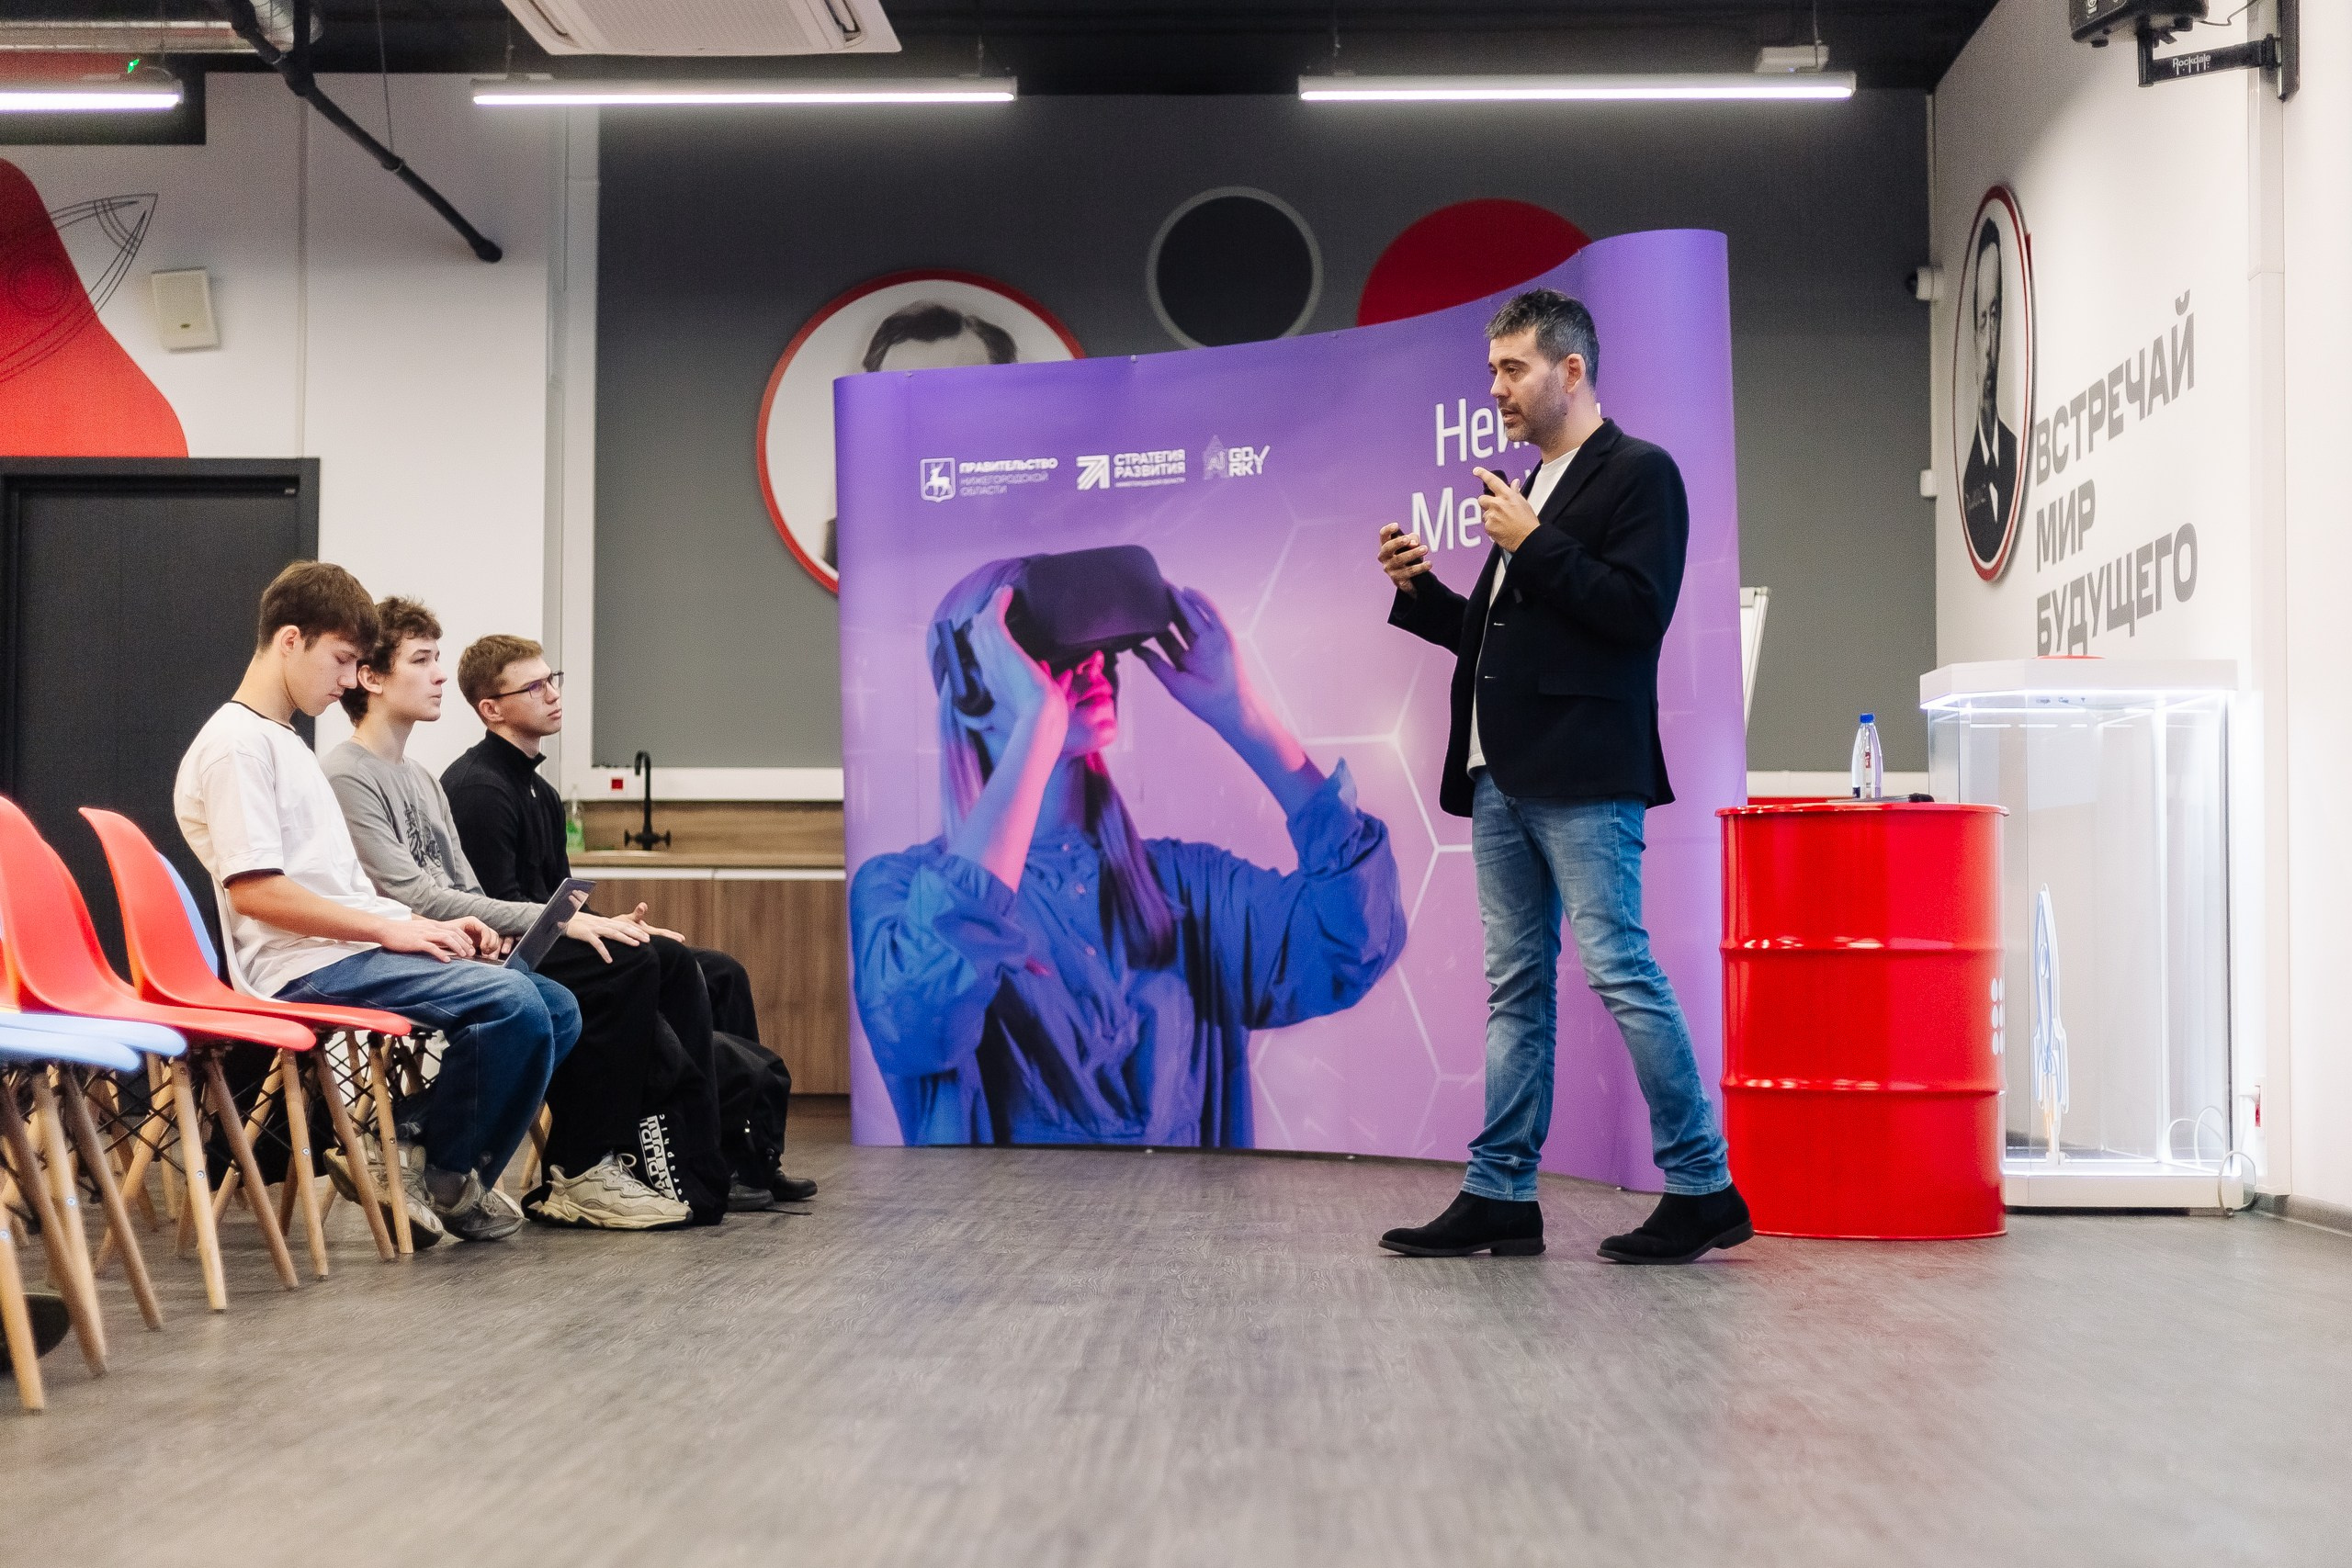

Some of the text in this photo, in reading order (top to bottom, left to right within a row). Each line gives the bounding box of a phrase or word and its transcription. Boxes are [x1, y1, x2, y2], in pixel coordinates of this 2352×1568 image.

[2172, 53, 2211, 76] Rockdale
[2036, 288, 2195, 487] ВСТРЕЧАЙ
[959, 457, 1059, 474] ПРАВИТЕЛЬСТВО
[1114, 449, 1186, 466] СТРАТЕГИЯ
[1114, 461, 1186, 479] РАЗВИТИЯ
[2036, 479, 2096, 574] МИР
[2036, 523, 2199, 657] БУДУЩЕГО
